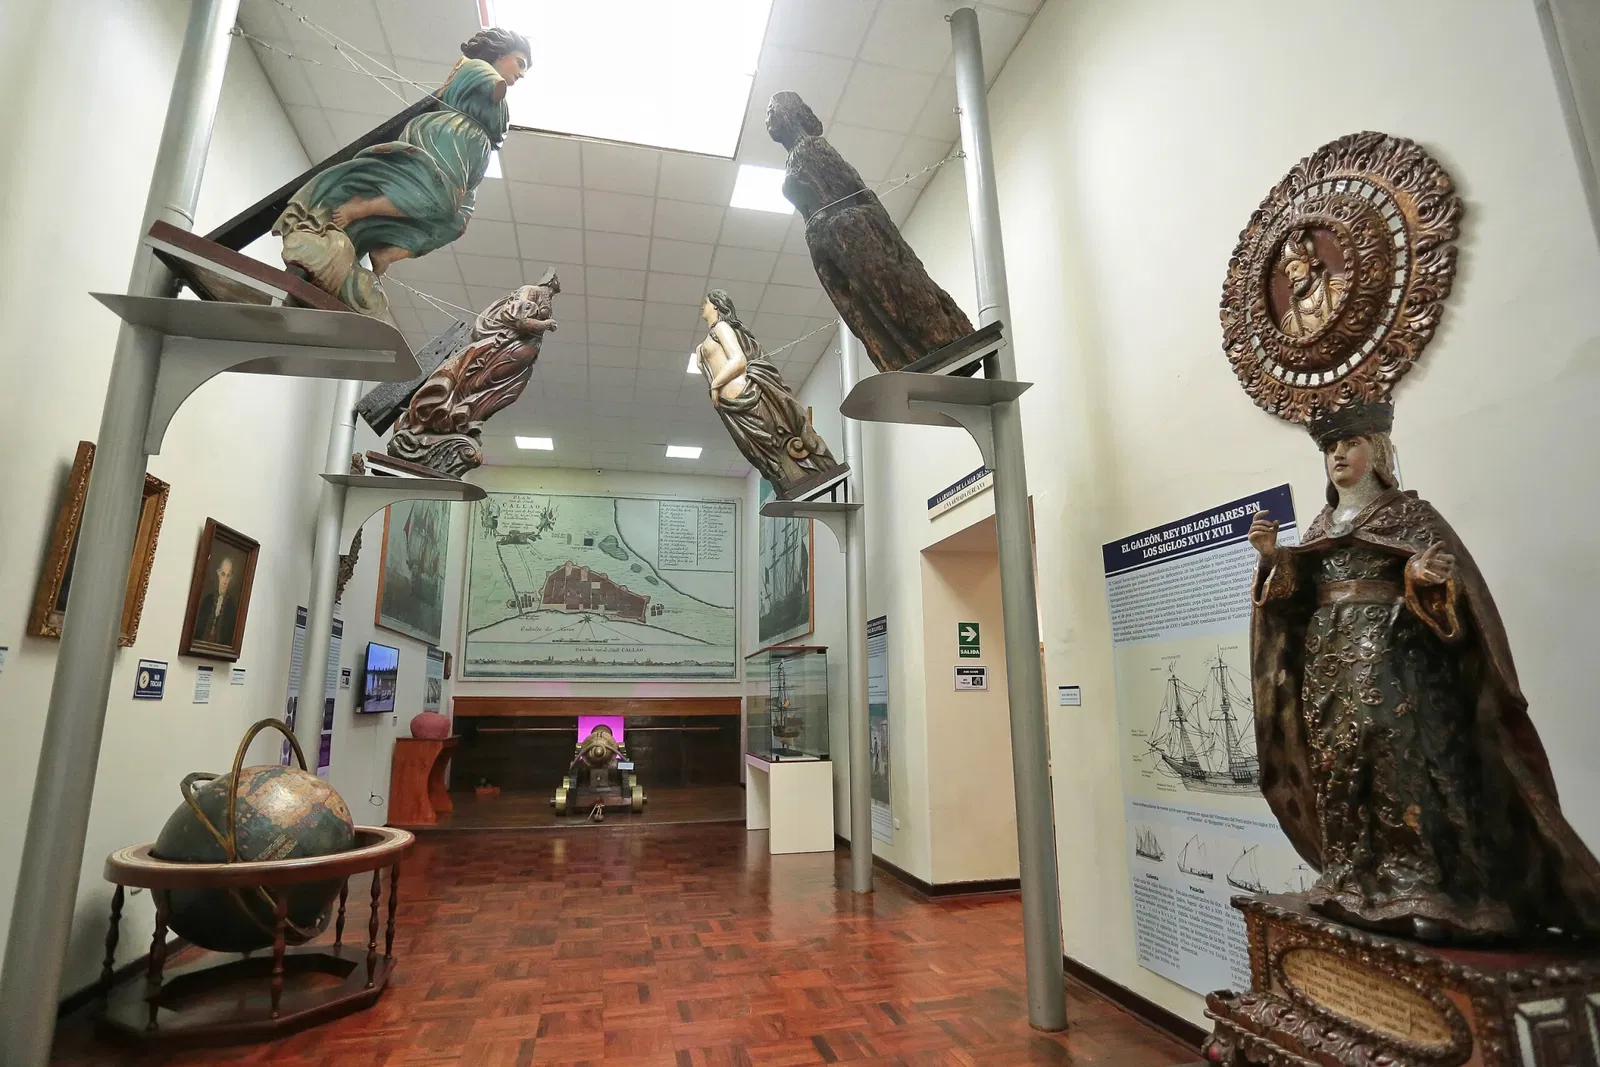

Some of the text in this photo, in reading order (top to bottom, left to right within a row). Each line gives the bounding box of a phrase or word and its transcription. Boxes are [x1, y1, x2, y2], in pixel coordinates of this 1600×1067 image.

[1121, 501, 1260, 553] EL GALEÓN, REY DE LOS MARES EN
[1143, 524, 1232, 558] LOS SIGLOS XVI Y XVII
